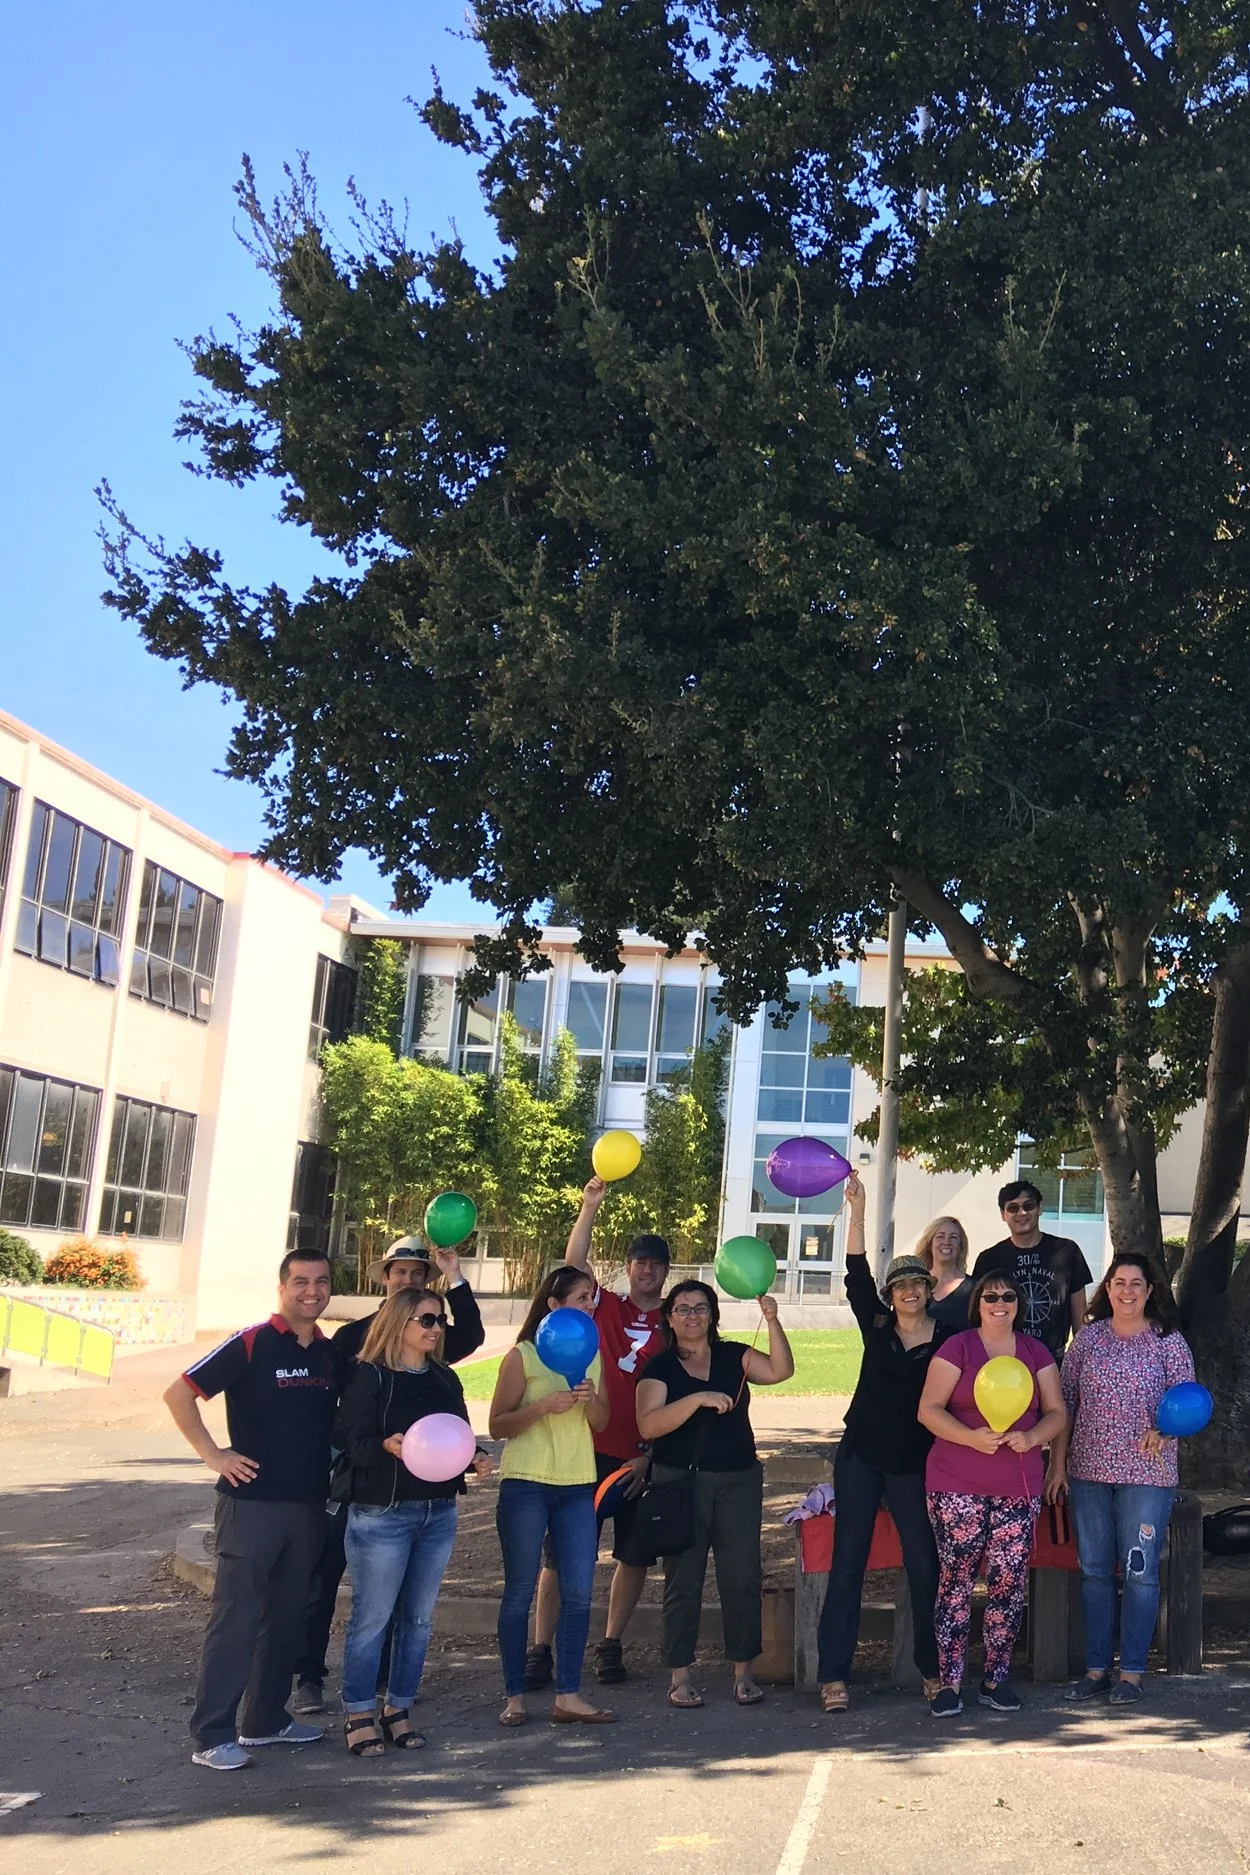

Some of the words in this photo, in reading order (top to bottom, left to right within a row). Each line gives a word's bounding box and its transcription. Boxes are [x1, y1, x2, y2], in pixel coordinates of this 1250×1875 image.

[1032, 1267, 1055, 1280] NAVAL
[617, 1327, 652, 1373] 7
[275, 1368, 309, 1378] SLAM
